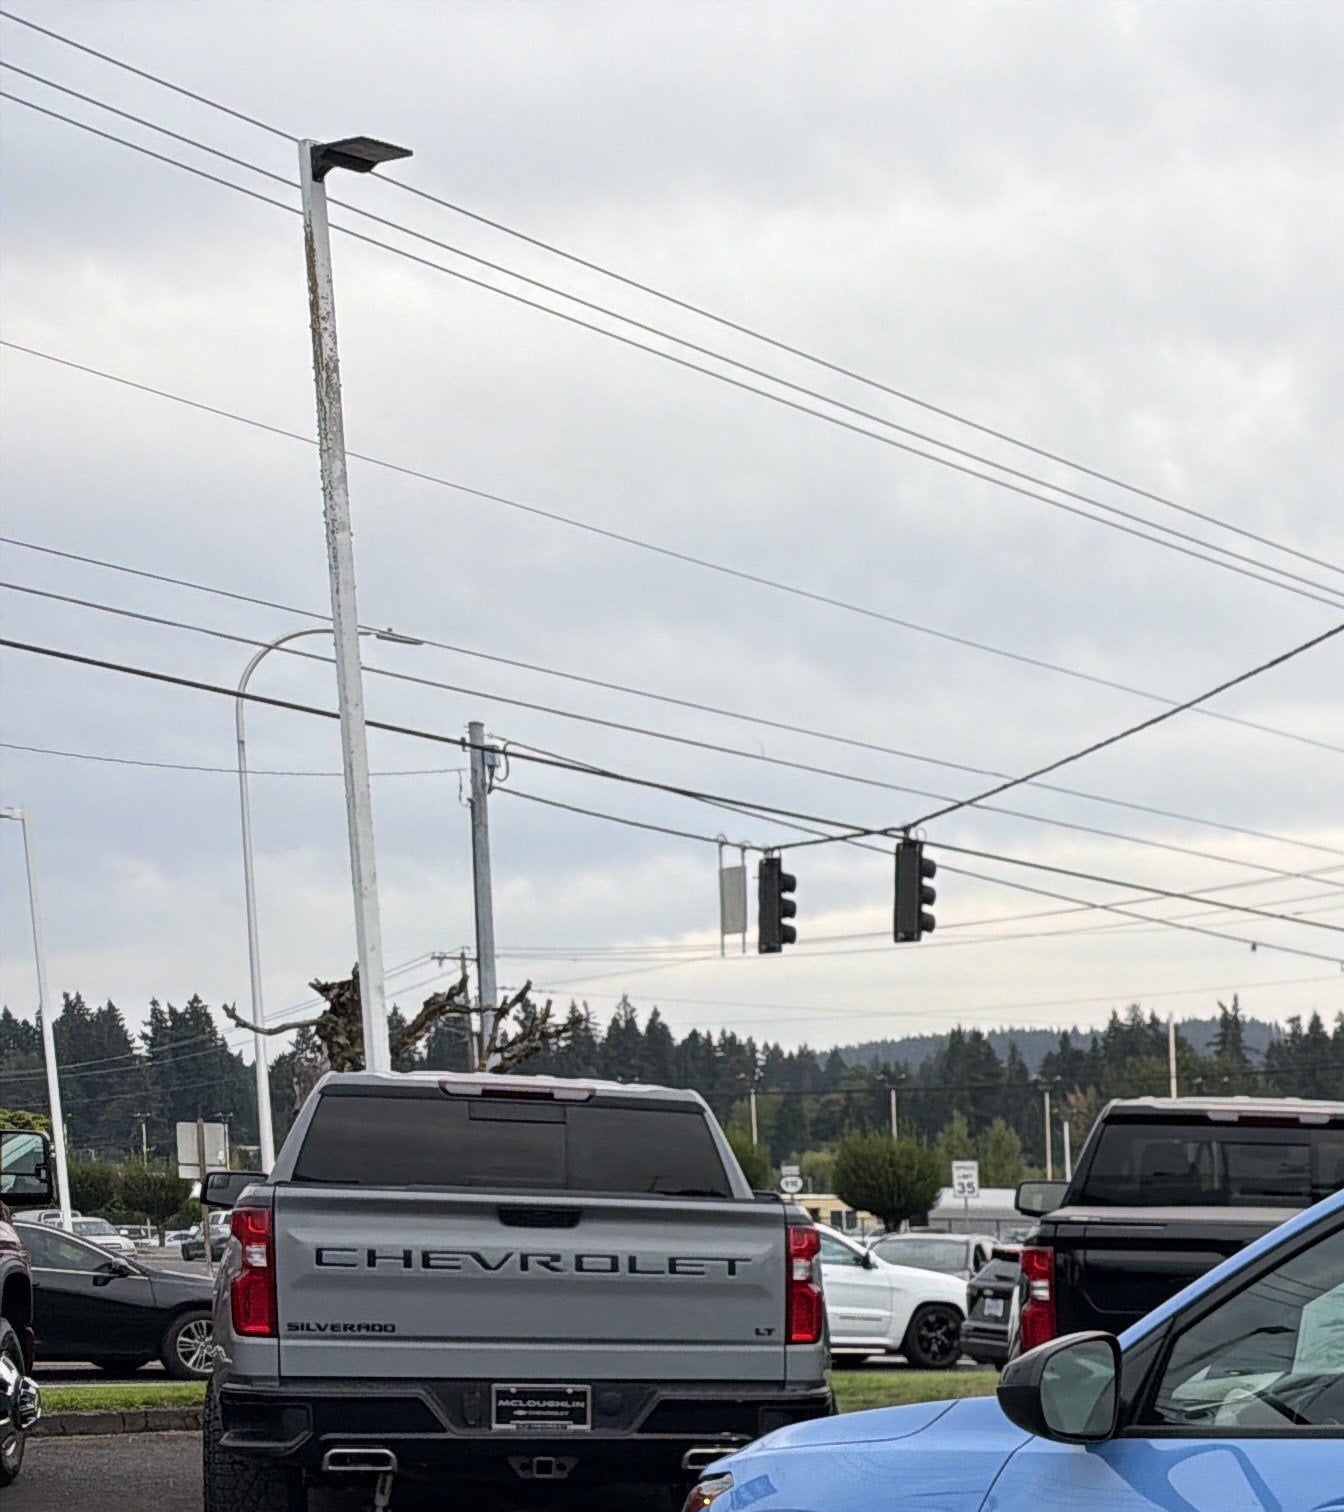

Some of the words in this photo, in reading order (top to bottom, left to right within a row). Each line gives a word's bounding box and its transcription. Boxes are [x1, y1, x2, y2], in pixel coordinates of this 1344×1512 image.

[958, 1182, 975, 1194] 35
[314, 1246, 752, 1277] CHEVROLET
[286, 1322, 396, 1334] SILVERADO
[755, 1327, 775, 1337] LT
